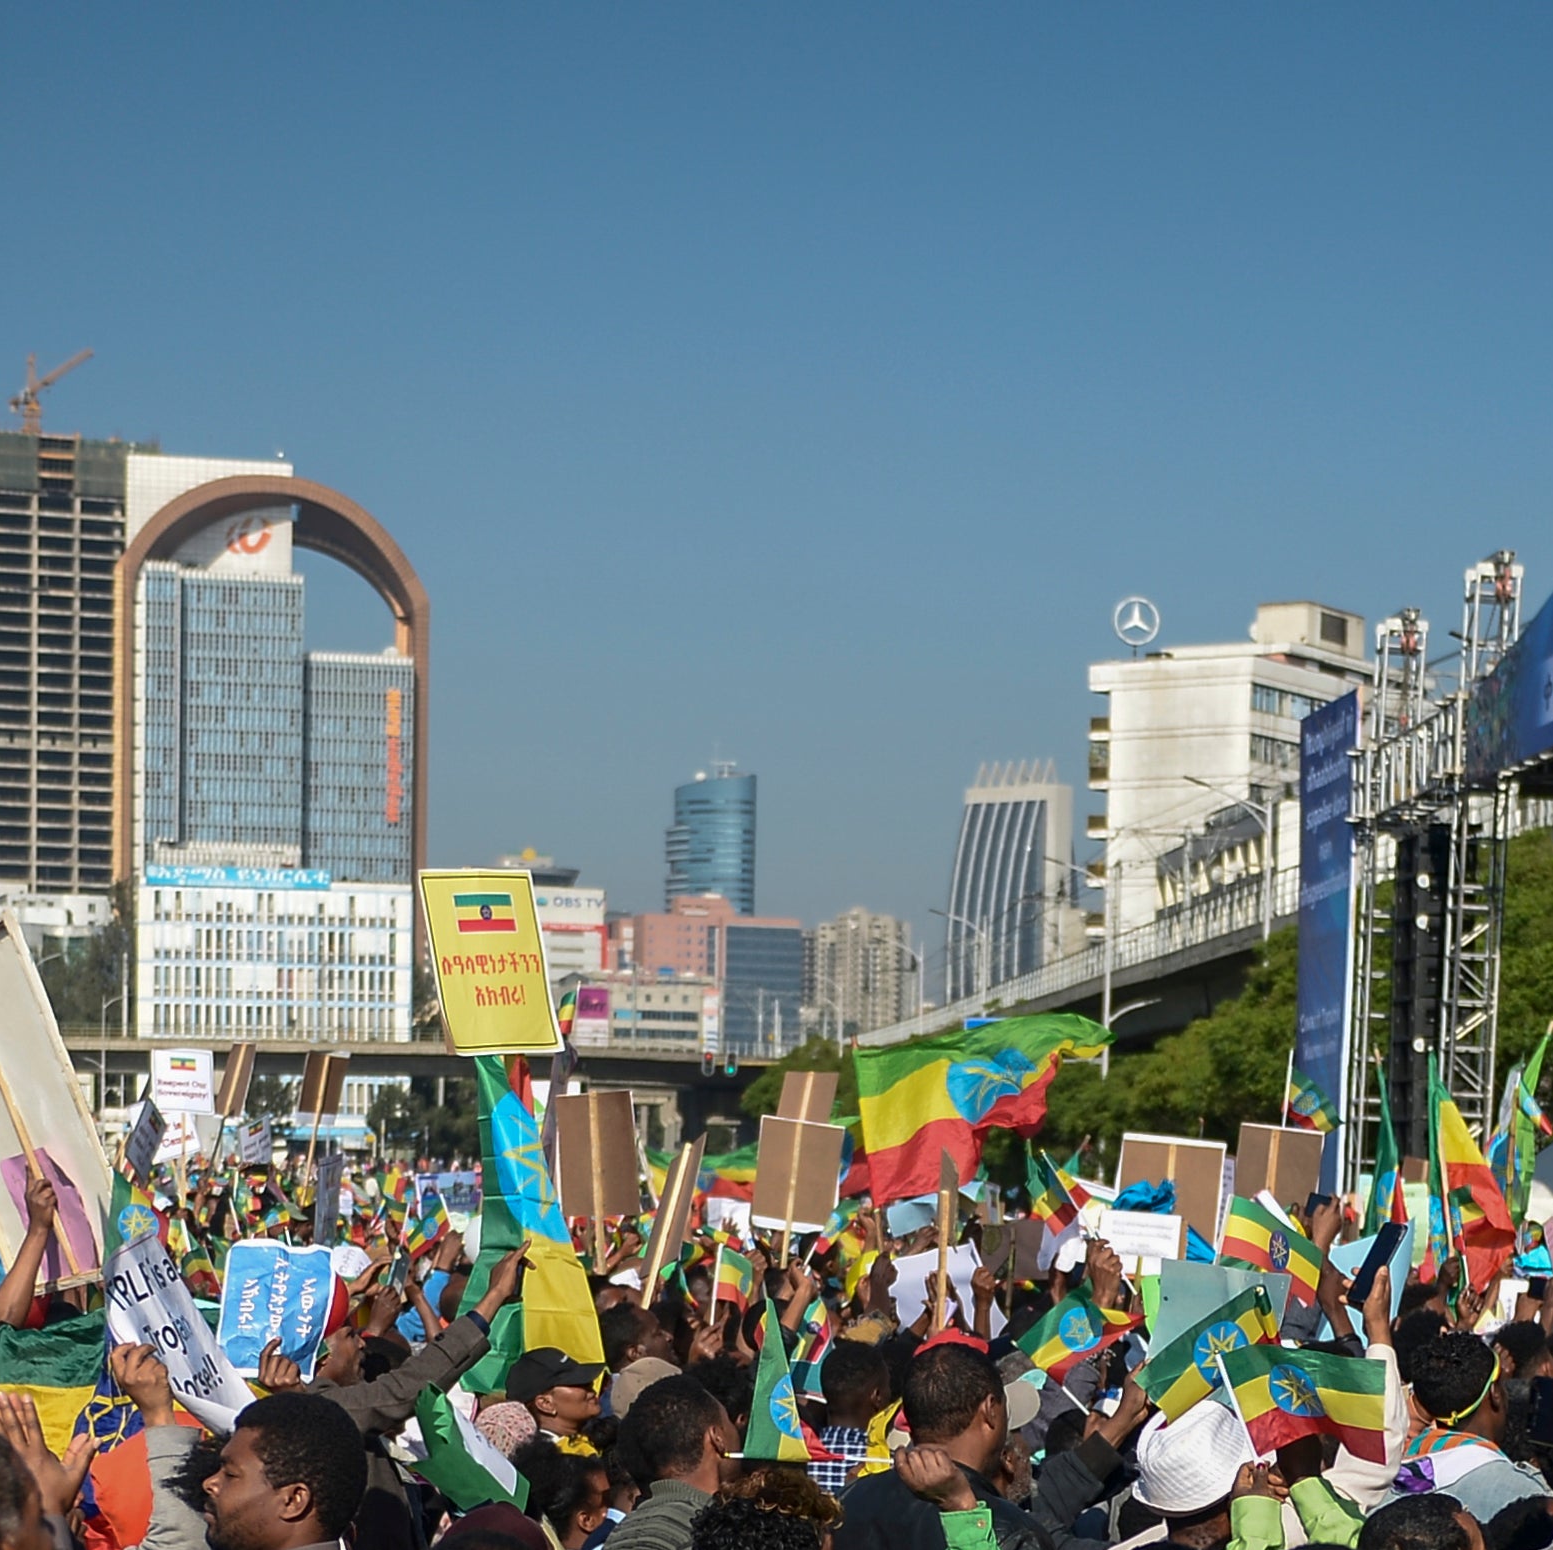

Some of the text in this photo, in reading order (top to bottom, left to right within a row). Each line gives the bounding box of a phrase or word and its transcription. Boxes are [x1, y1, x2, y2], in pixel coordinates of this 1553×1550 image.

[553, 896, 603, 908] OBS TV
[107, 1257, 178, 1311] TPLF is a
